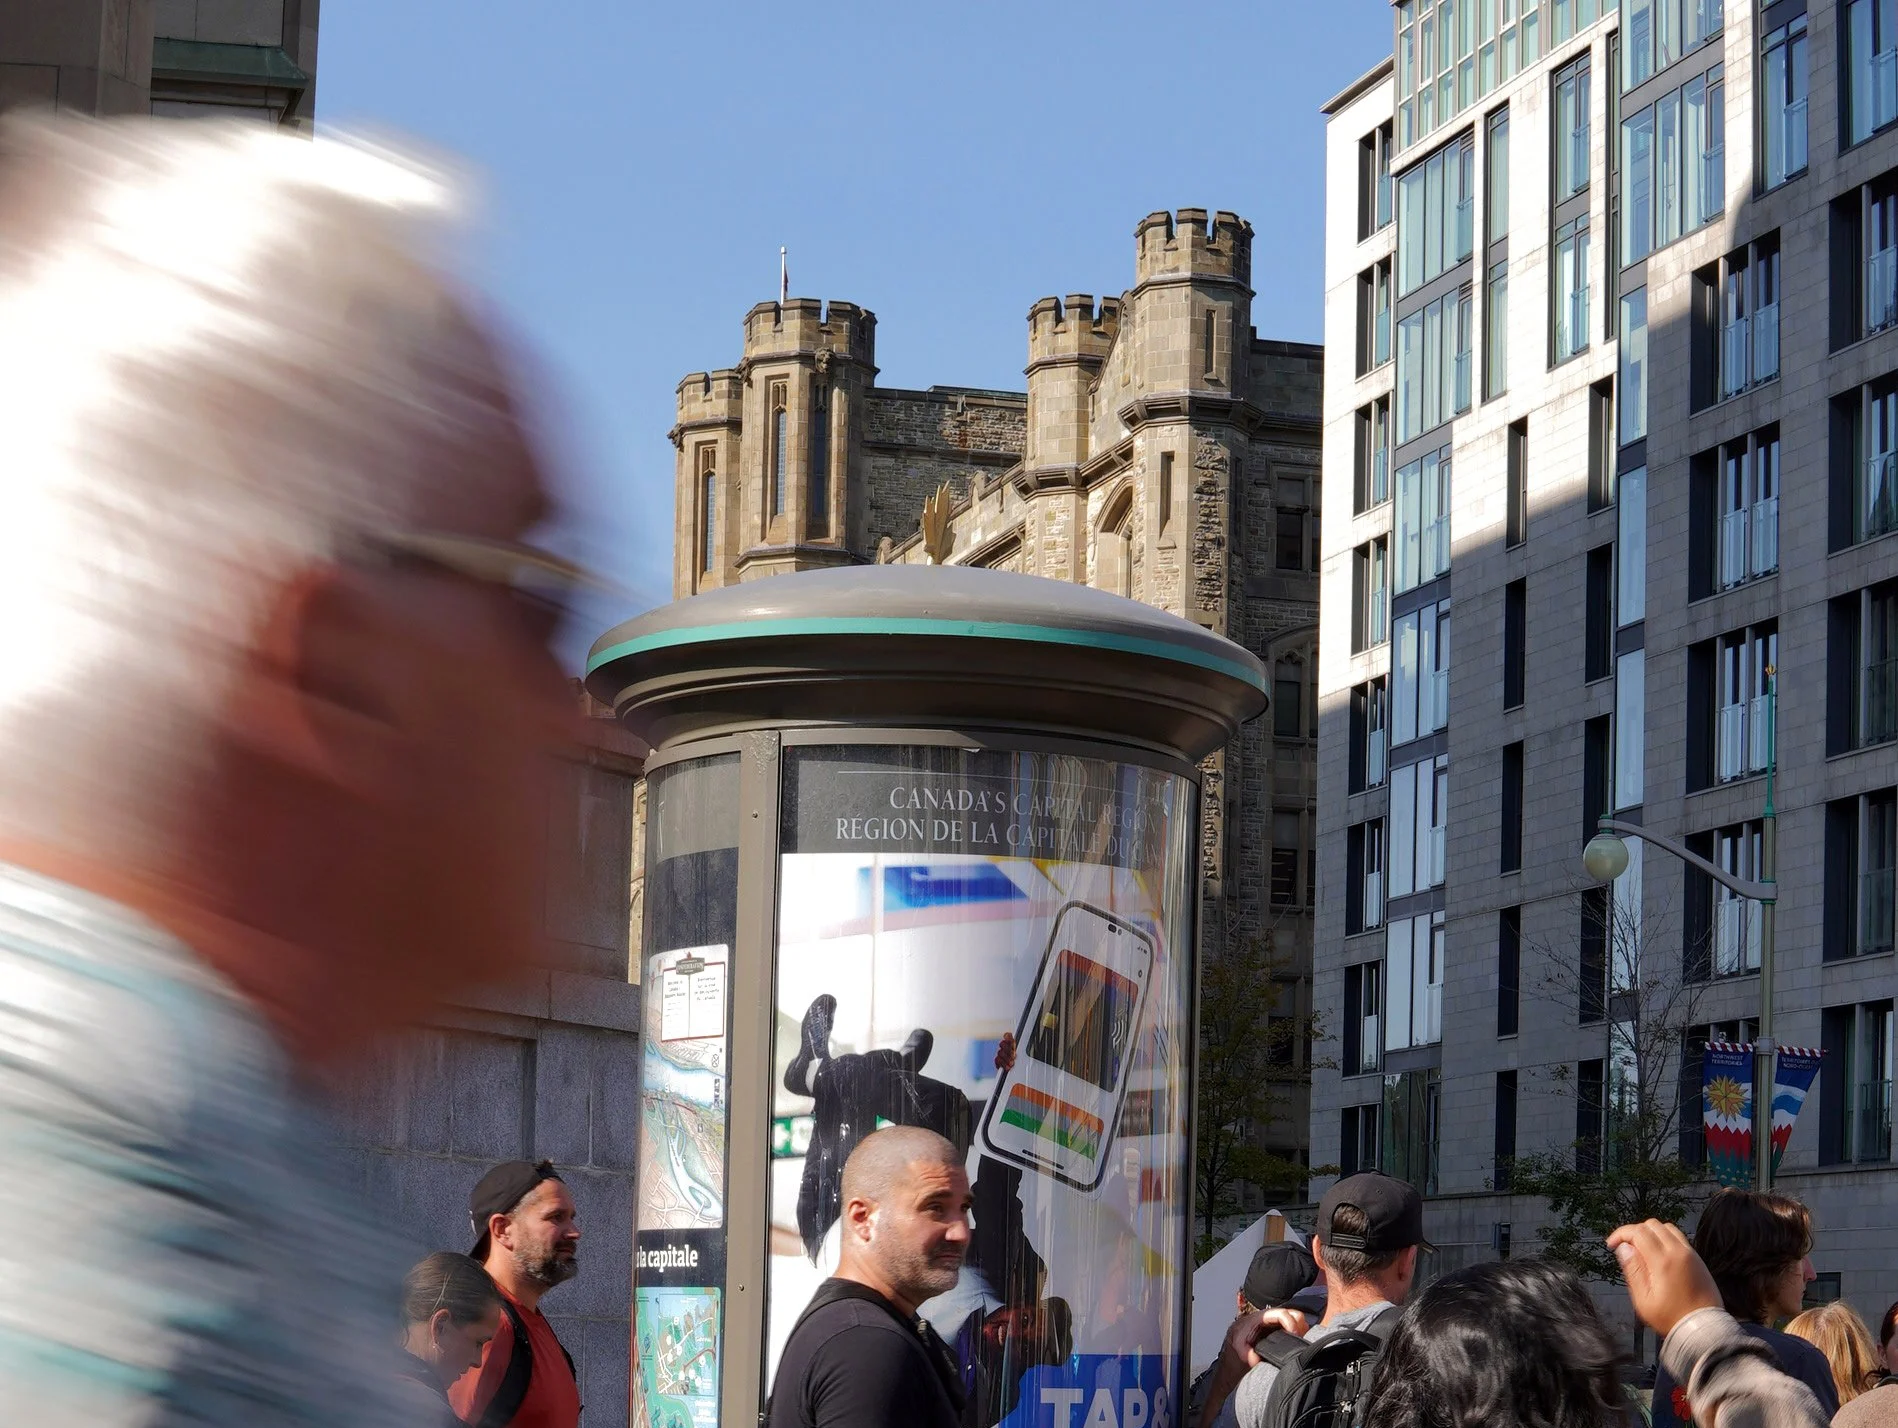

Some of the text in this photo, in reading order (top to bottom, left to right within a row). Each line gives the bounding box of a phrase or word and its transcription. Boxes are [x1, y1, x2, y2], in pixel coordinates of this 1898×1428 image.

[889, 787, 1006, 814] CANADA'S
[836, 814, 925, 840] RÉGION
[932, 819, 964, 842] DE
[971, 821, 1000, 843] LA
[1006, 823, 1101, 853] CAPITALE
[647, 1244, 698, 1273] capitale
